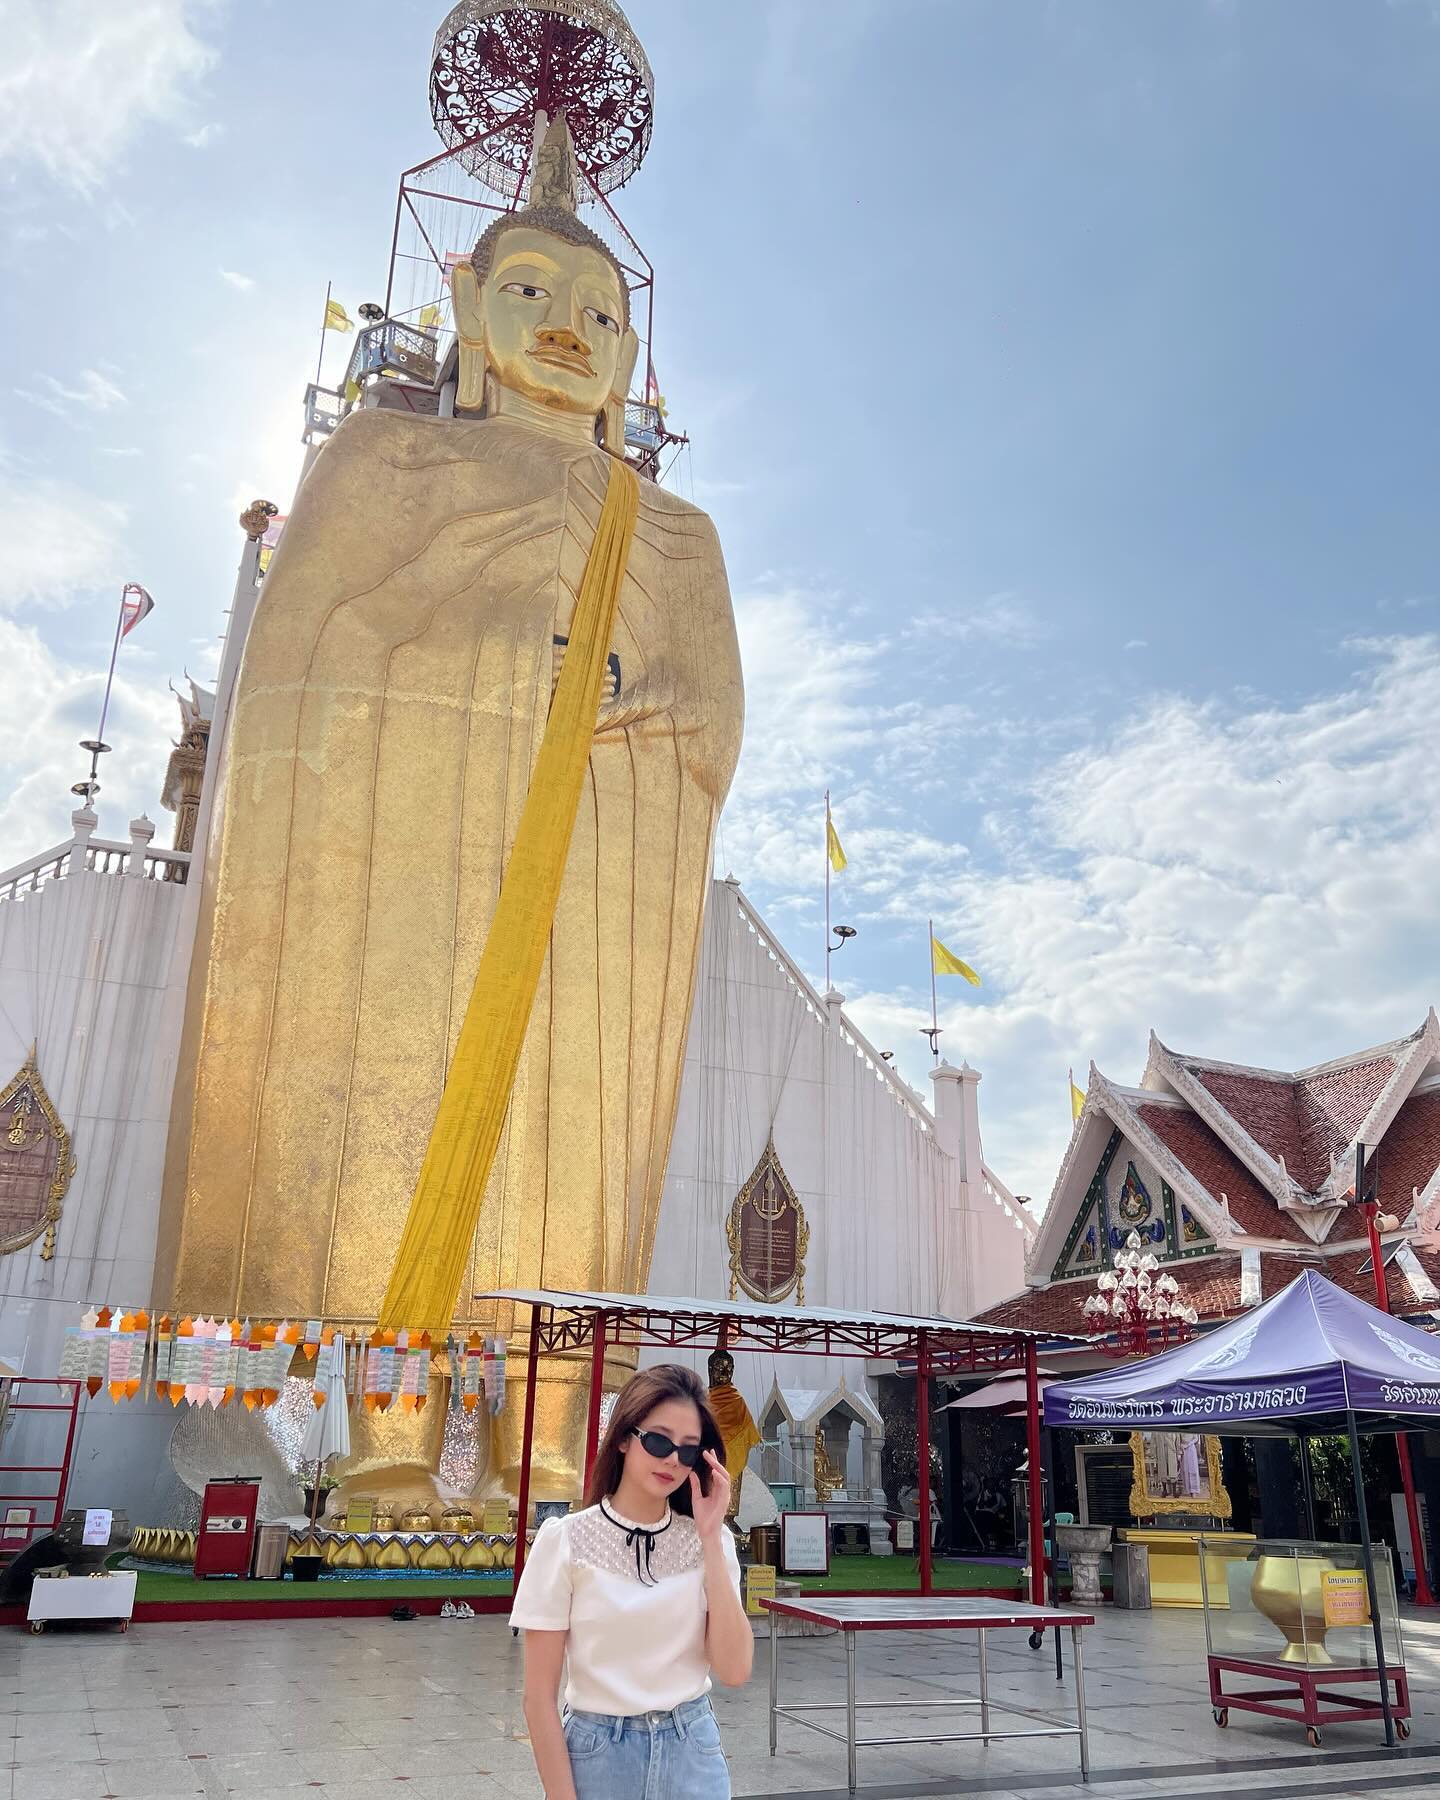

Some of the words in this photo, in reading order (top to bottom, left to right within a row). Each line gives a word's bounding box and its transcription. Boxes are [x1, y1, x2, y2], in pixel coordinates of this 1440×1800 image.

[1068, 1395, 1165, 1419] วัดอินทรวิหาร
[1171, 1386, 1307, 1416] พระอารามหลวง
